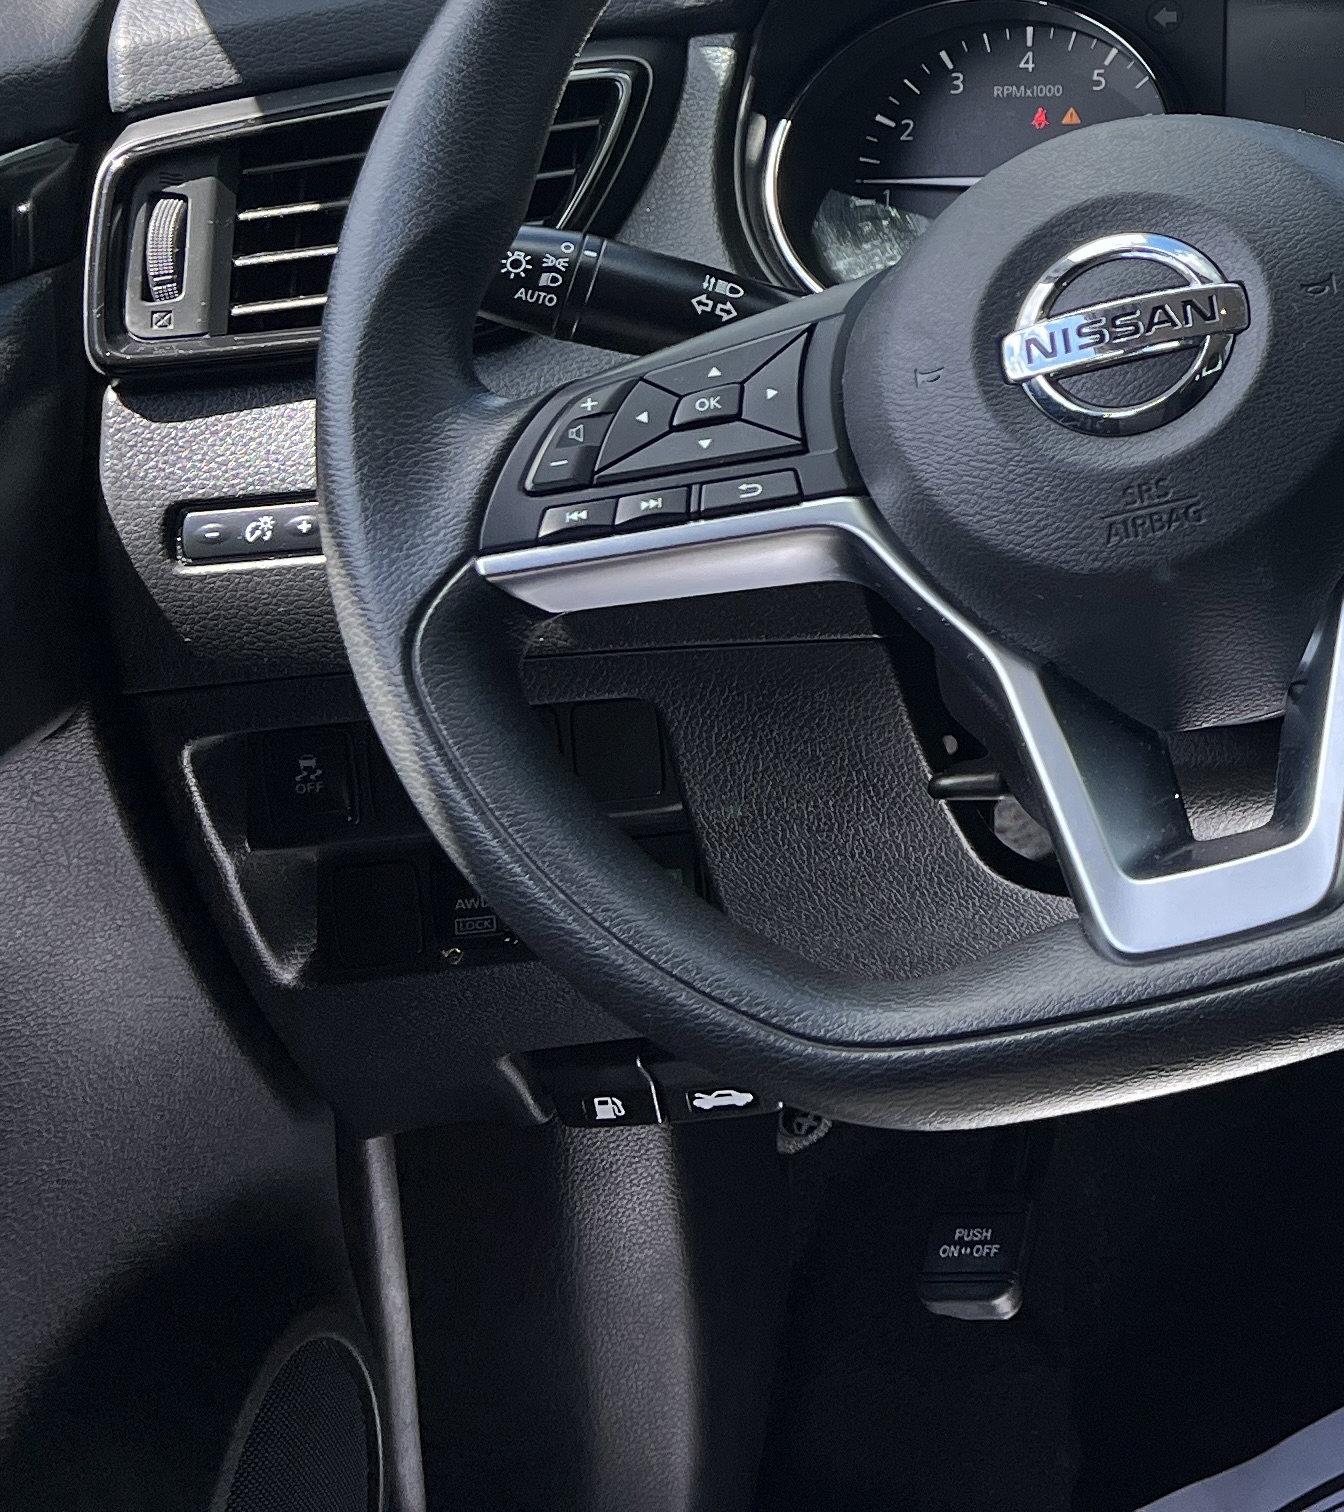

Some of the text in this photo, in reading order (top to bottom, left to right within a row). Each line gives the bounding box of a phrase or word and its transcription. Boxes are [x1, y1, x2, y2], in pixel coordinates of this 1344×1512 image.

[1019, 51, 1035, 72] 4
[950, 72, 964, 95] 3
[1092, 69, 1106, 91] 5
[993, 84, 1062, 98] RPMx1000
[899, 119, 914, 141] 2
[514, 288, 558, 308] AUTO
[1025, 295, 1220, 366] NISSAN
[695, 397, 722, 411] OK
[295, 781, 323, 794] OFF
[459, 919, 493, 931] LOCK
[954, 1228, 992, 1241] PUSH
